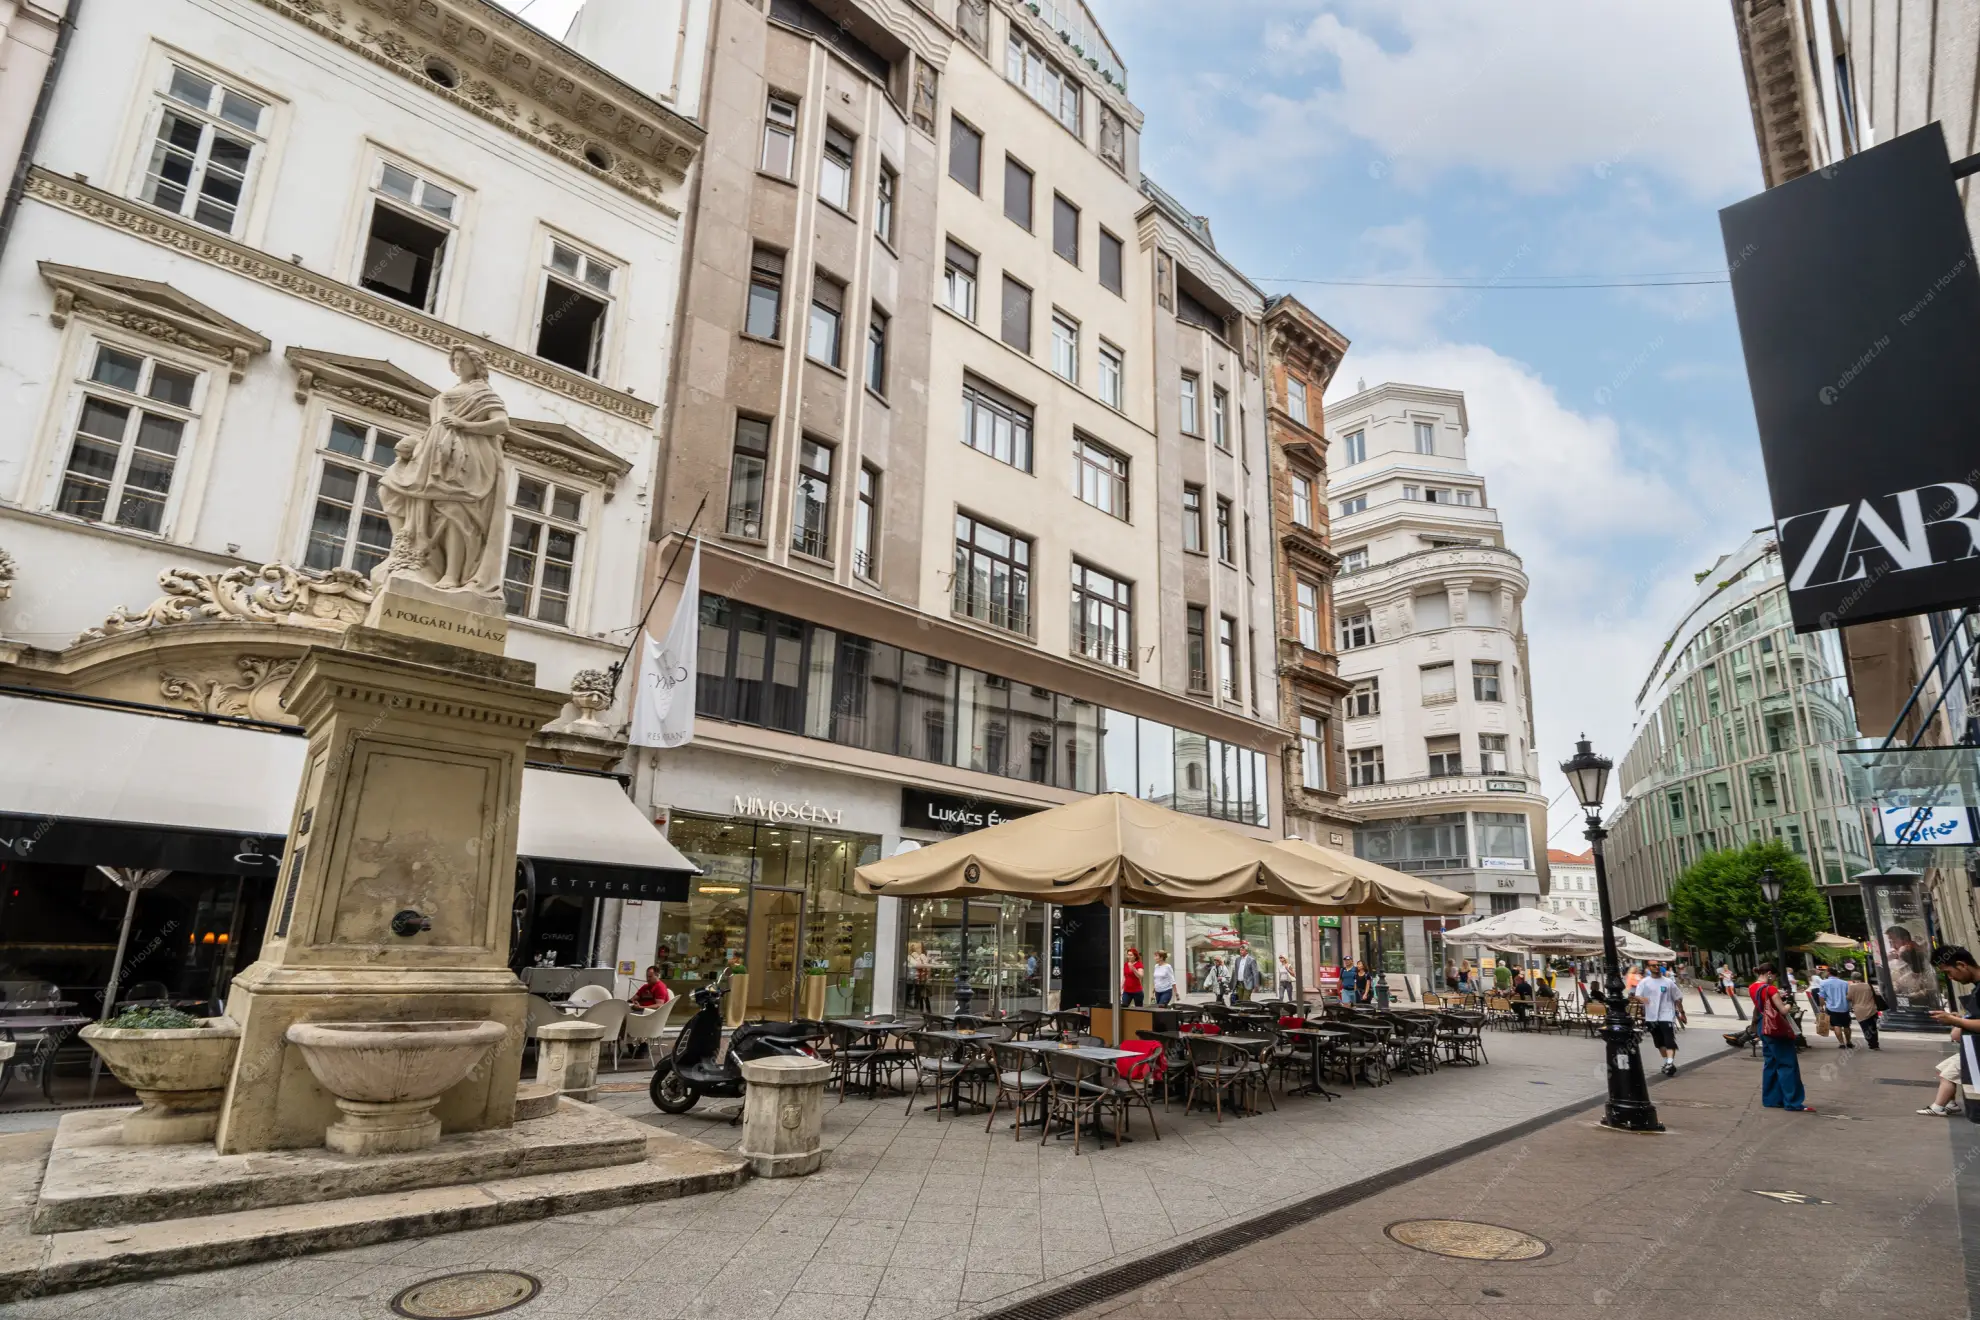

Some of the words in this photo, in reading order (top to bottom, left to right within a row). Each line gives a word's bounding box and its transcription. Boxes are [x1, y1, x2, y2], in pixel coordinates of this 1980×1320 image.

[1778, 482, 1980, 592] ZAR
[383, 608, 392, 617] A
[396, 610, 452, 631] POLGÁRI
[456, 624, 505, 642] HALÁSZ
[1894, 819, 1959, 842] Coffee
[551, 877, 667, 893] ÉTTEREM
[541, 932, 574, 942] CYRANO
